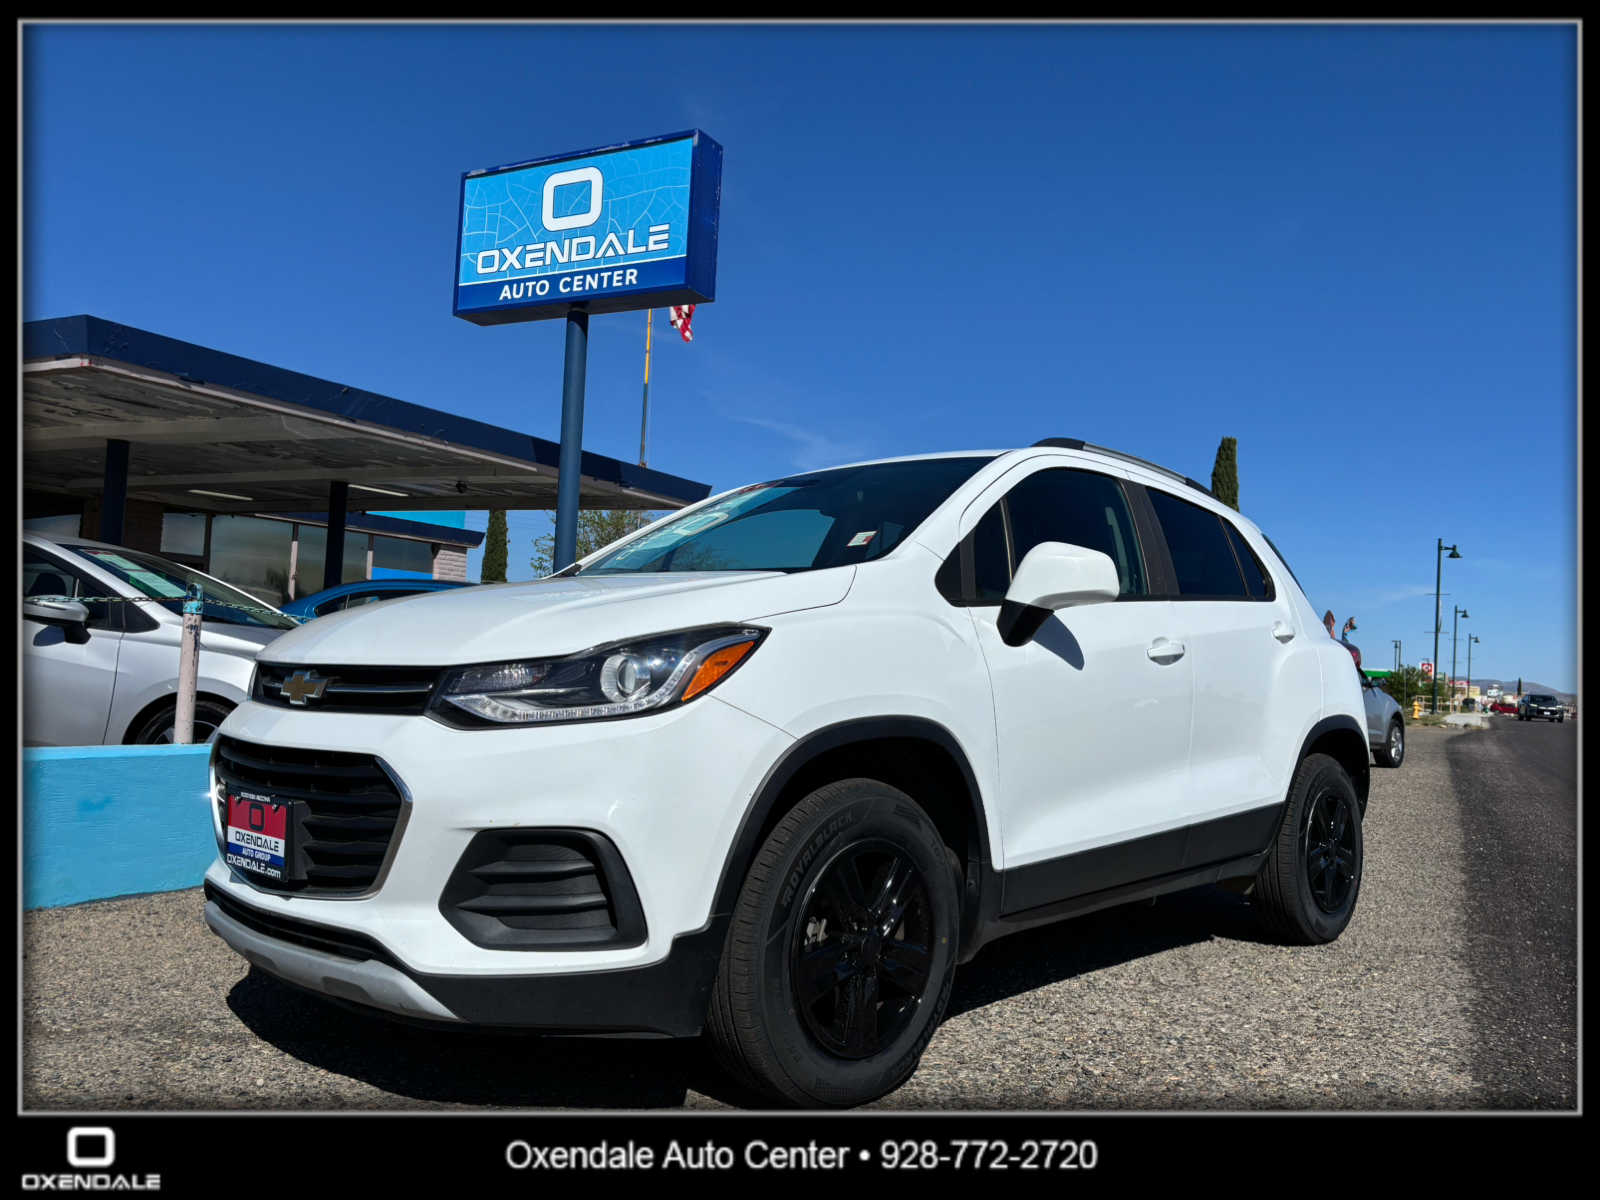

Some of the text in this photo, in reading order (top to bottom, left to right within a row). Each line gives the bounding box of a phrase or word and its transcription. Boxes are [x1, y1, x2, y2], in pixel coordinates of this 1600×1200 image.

[476, 224, 670, 274] OXENDALE
[499, 268, 638, 300] AUTO CENTER
[235, 831, 279, 852] OXENDALE
[226, 854, 281, 878] OXENDALE.com
